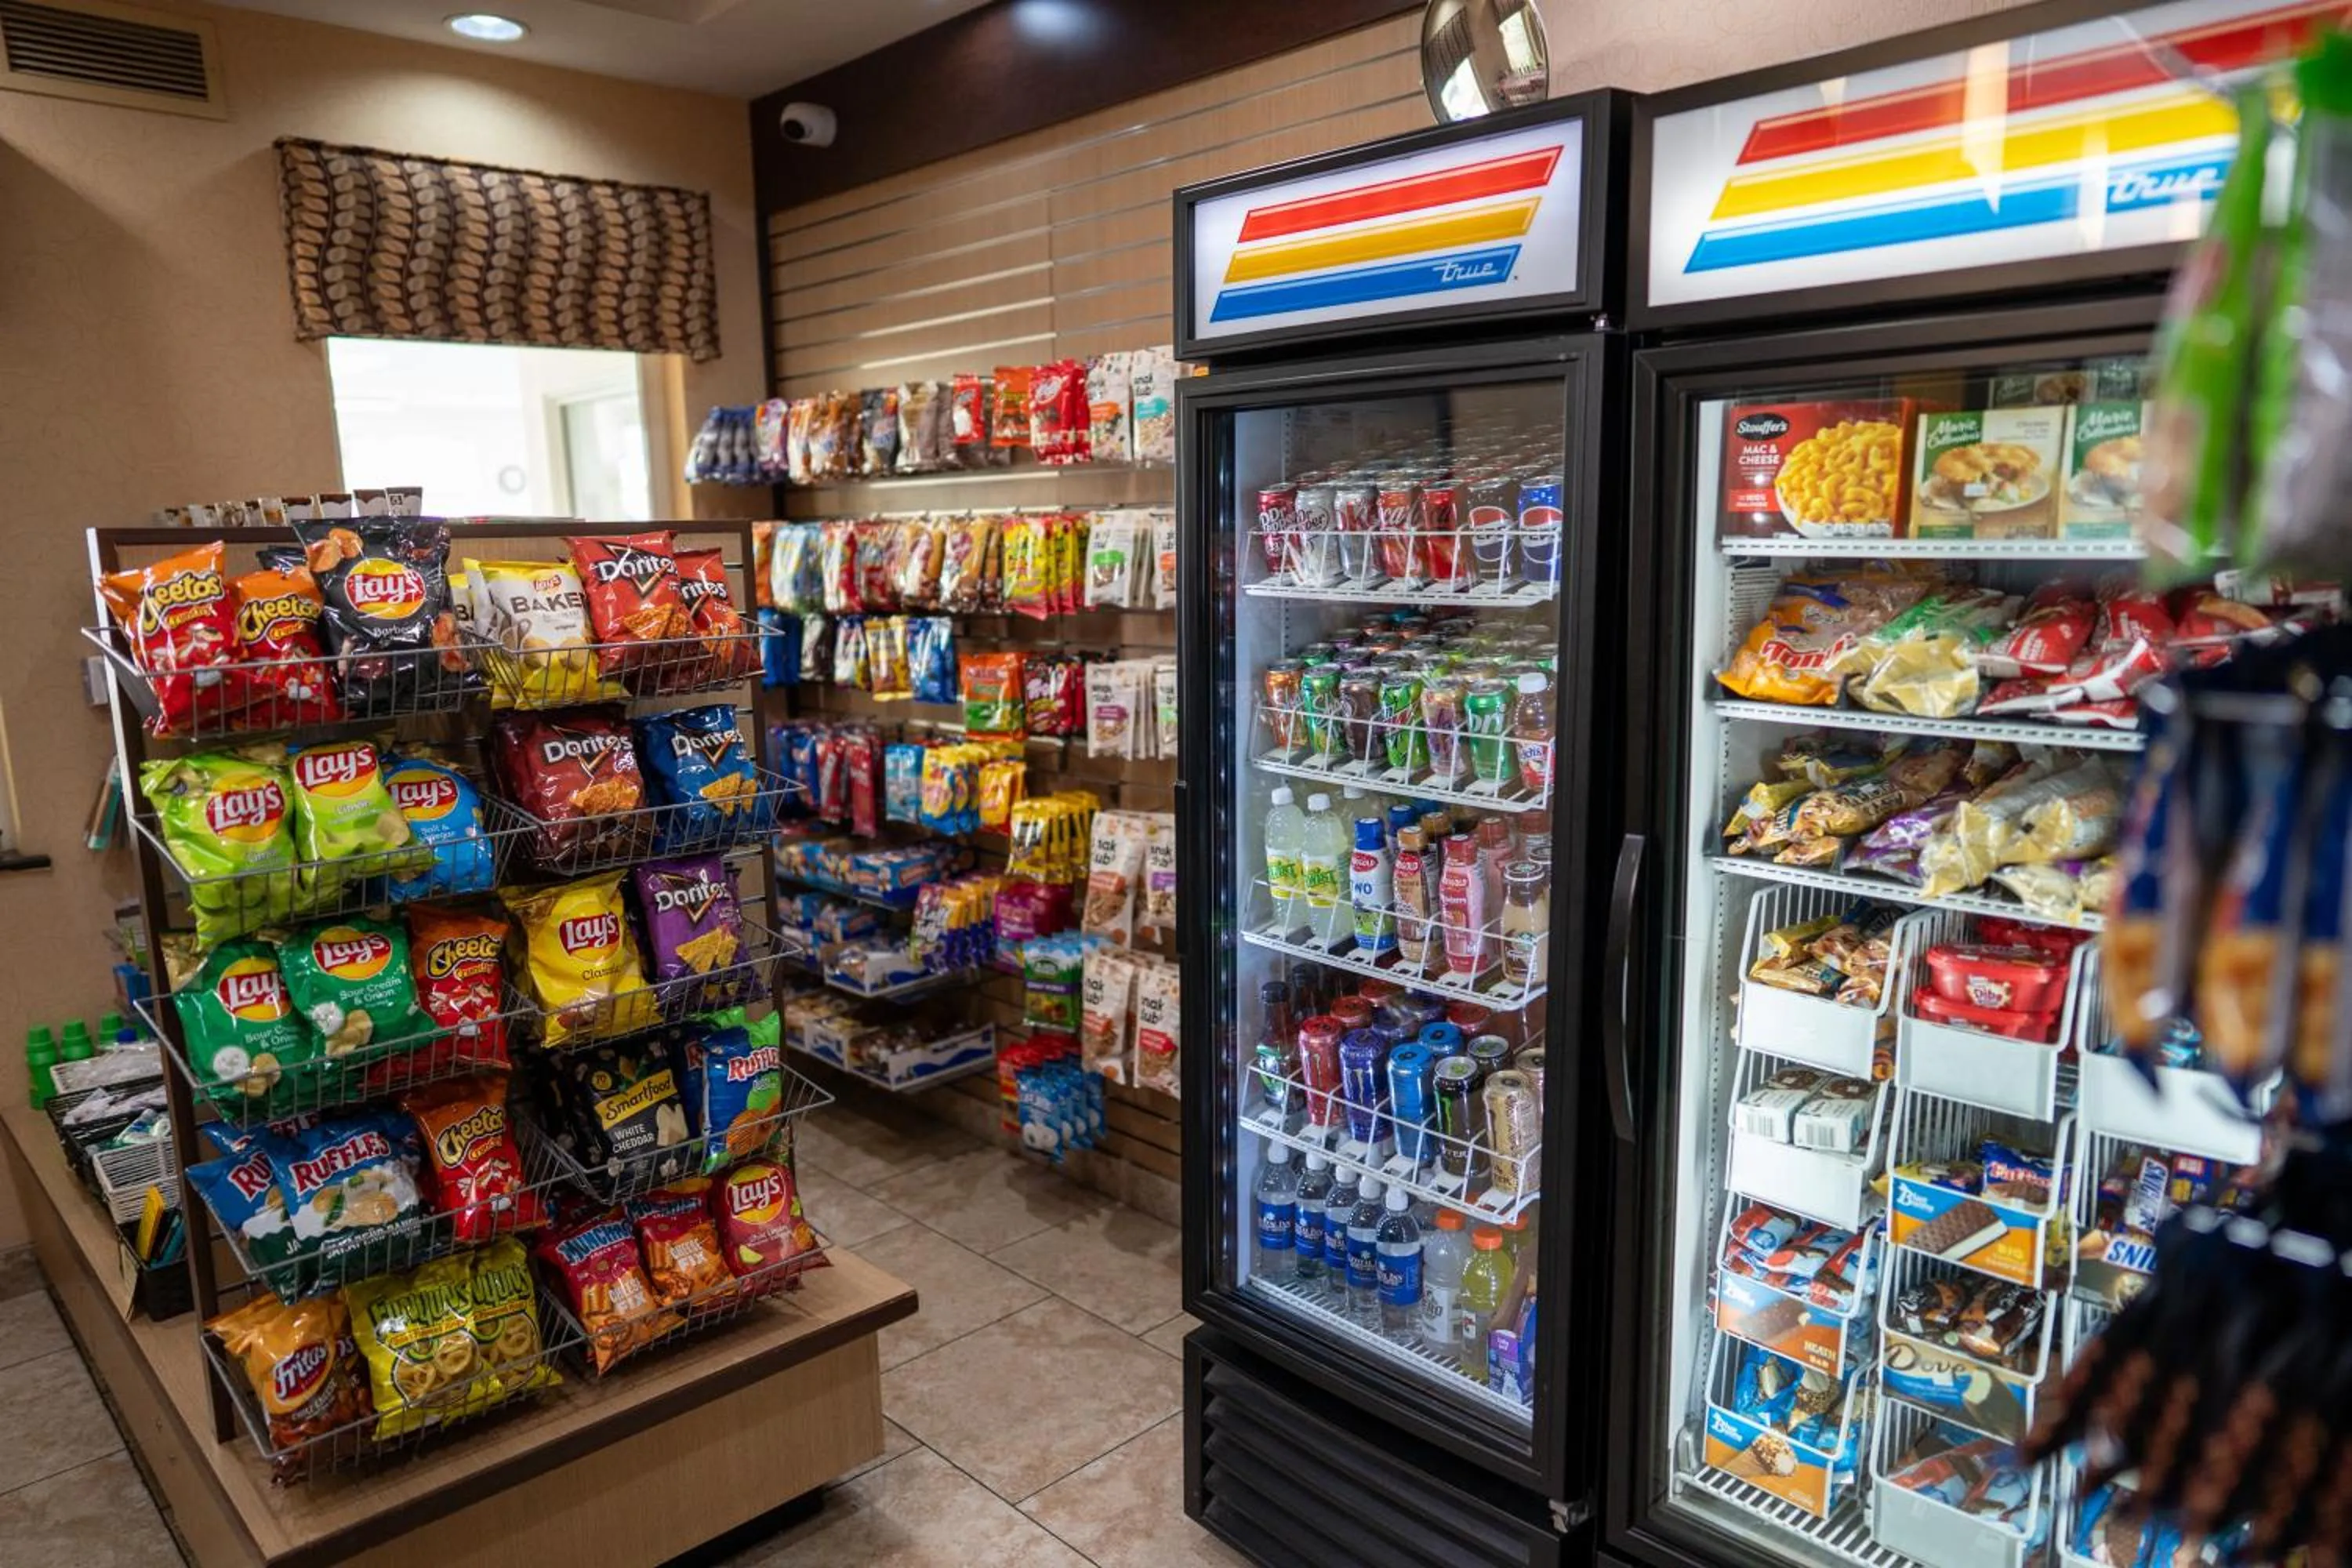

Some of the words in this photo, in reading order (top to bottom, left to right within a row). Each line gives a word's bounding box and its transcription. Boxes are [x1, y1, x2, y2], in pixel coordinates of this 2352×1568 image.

[1433, 260, 1498, 282] true
[353, 572, 422, 608] Lay's
[681, 580, 728, 601] ritos
[302, 745, 376, 787] Lay's
[543, 734, 634, 764] Doritos
[210, 782, 283, 831] Lay's
[565, 912, 619, 951] Lay's
[321, 933, 389, 969] Lay's
[604, 1074, 673, 1121] Smartfood
[614, 1123, 646, 1141] WHITE
[288, 1131, 393, 1196] RUFFLES
[731, 1174, 782, 1214] Lay's
